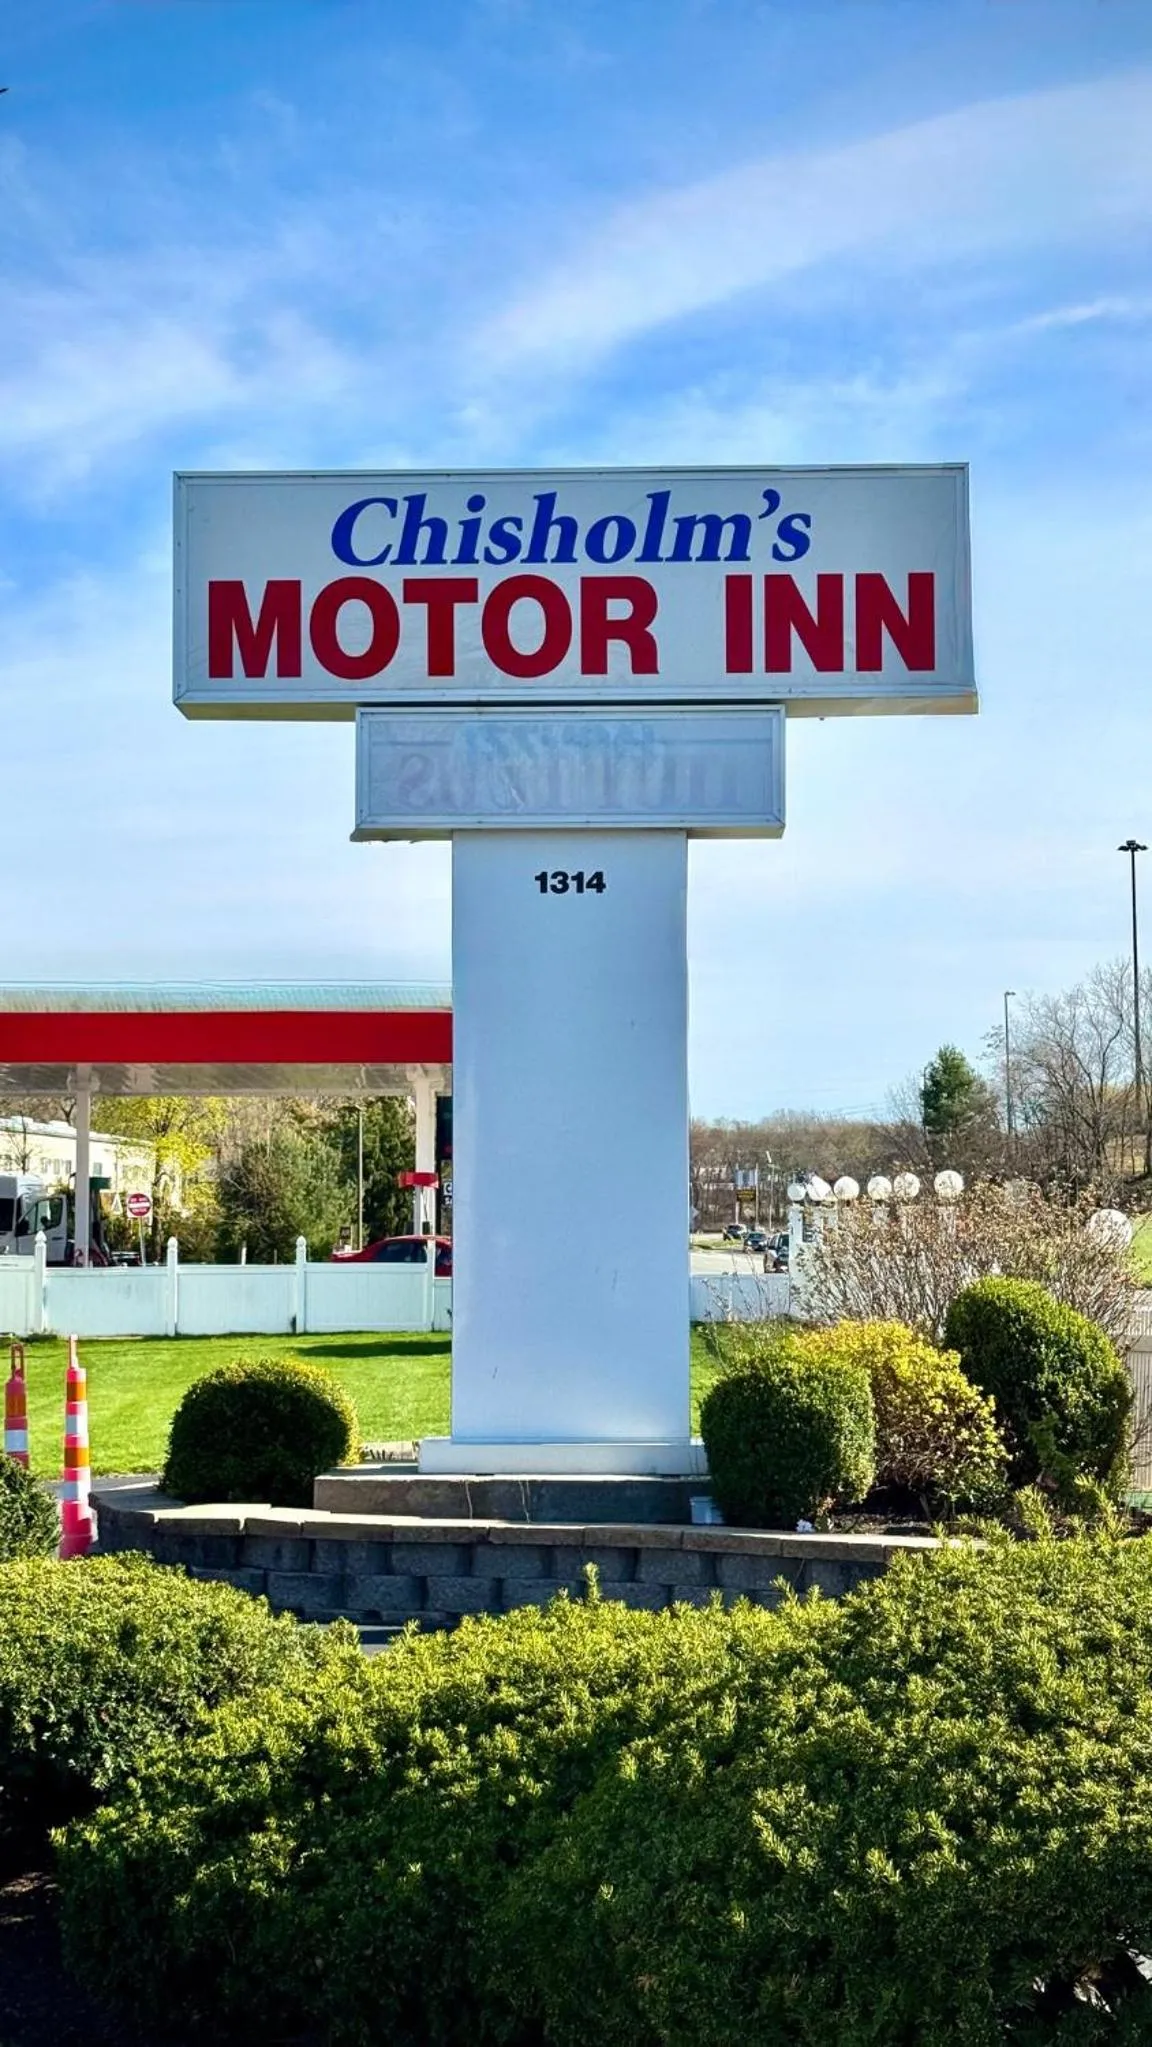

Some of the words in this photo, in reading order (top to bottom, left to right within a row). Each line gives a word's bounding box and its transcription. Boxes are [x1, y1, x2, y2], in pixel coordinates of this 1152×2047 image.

[331, 489, 812, 567] Chisholm’s
[208, 574, 660, 680] MOTOR
[725, 572, 936, 674] INN
[534, 871, 607, 894] 1314
